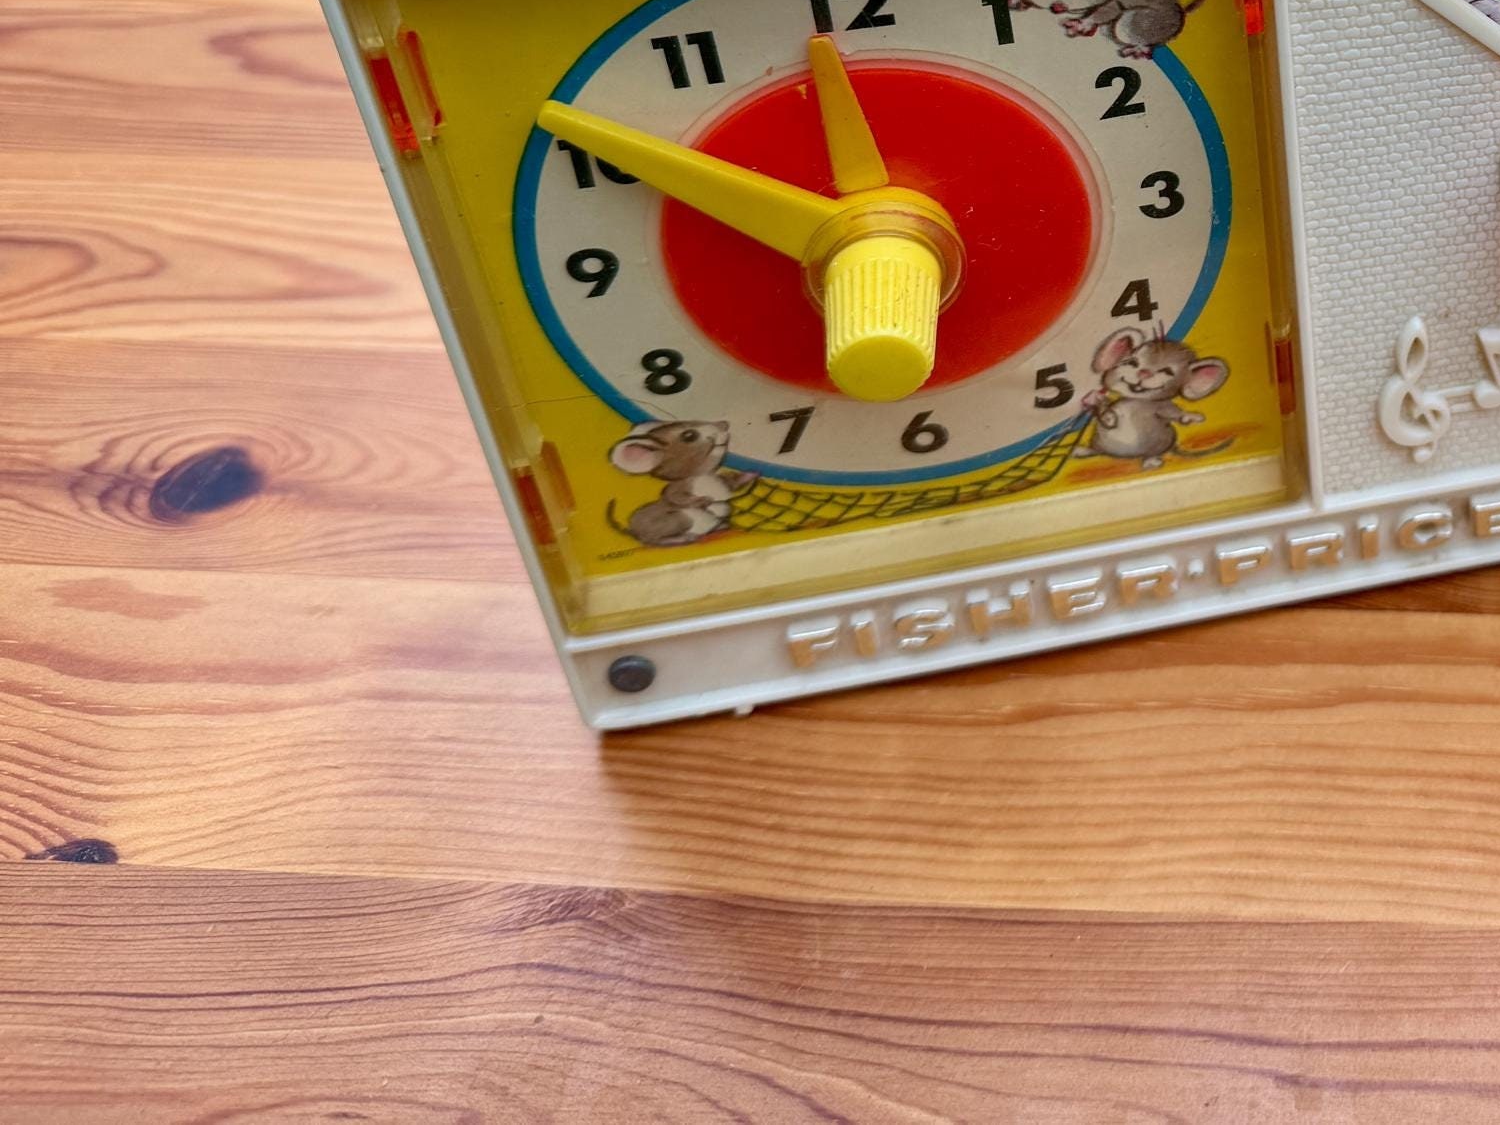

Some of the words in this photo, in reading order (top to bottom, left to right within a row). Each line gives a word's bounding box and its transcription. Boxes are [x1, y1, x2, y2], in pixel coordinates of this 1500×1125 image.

[650, 30, 726, 90] 11
[1094, 65, 1146, 121] 2
[1139, 170, 1185, 219] 3
[565, 248, 619, 299] 9
[1110, 278, 1158, 322] 4
[640, 348, 692, 396] 8
[1034, 363, 1074, 409] 5
[769, 406, 815, 454] 7
[901, 411, 948, 454] 6
